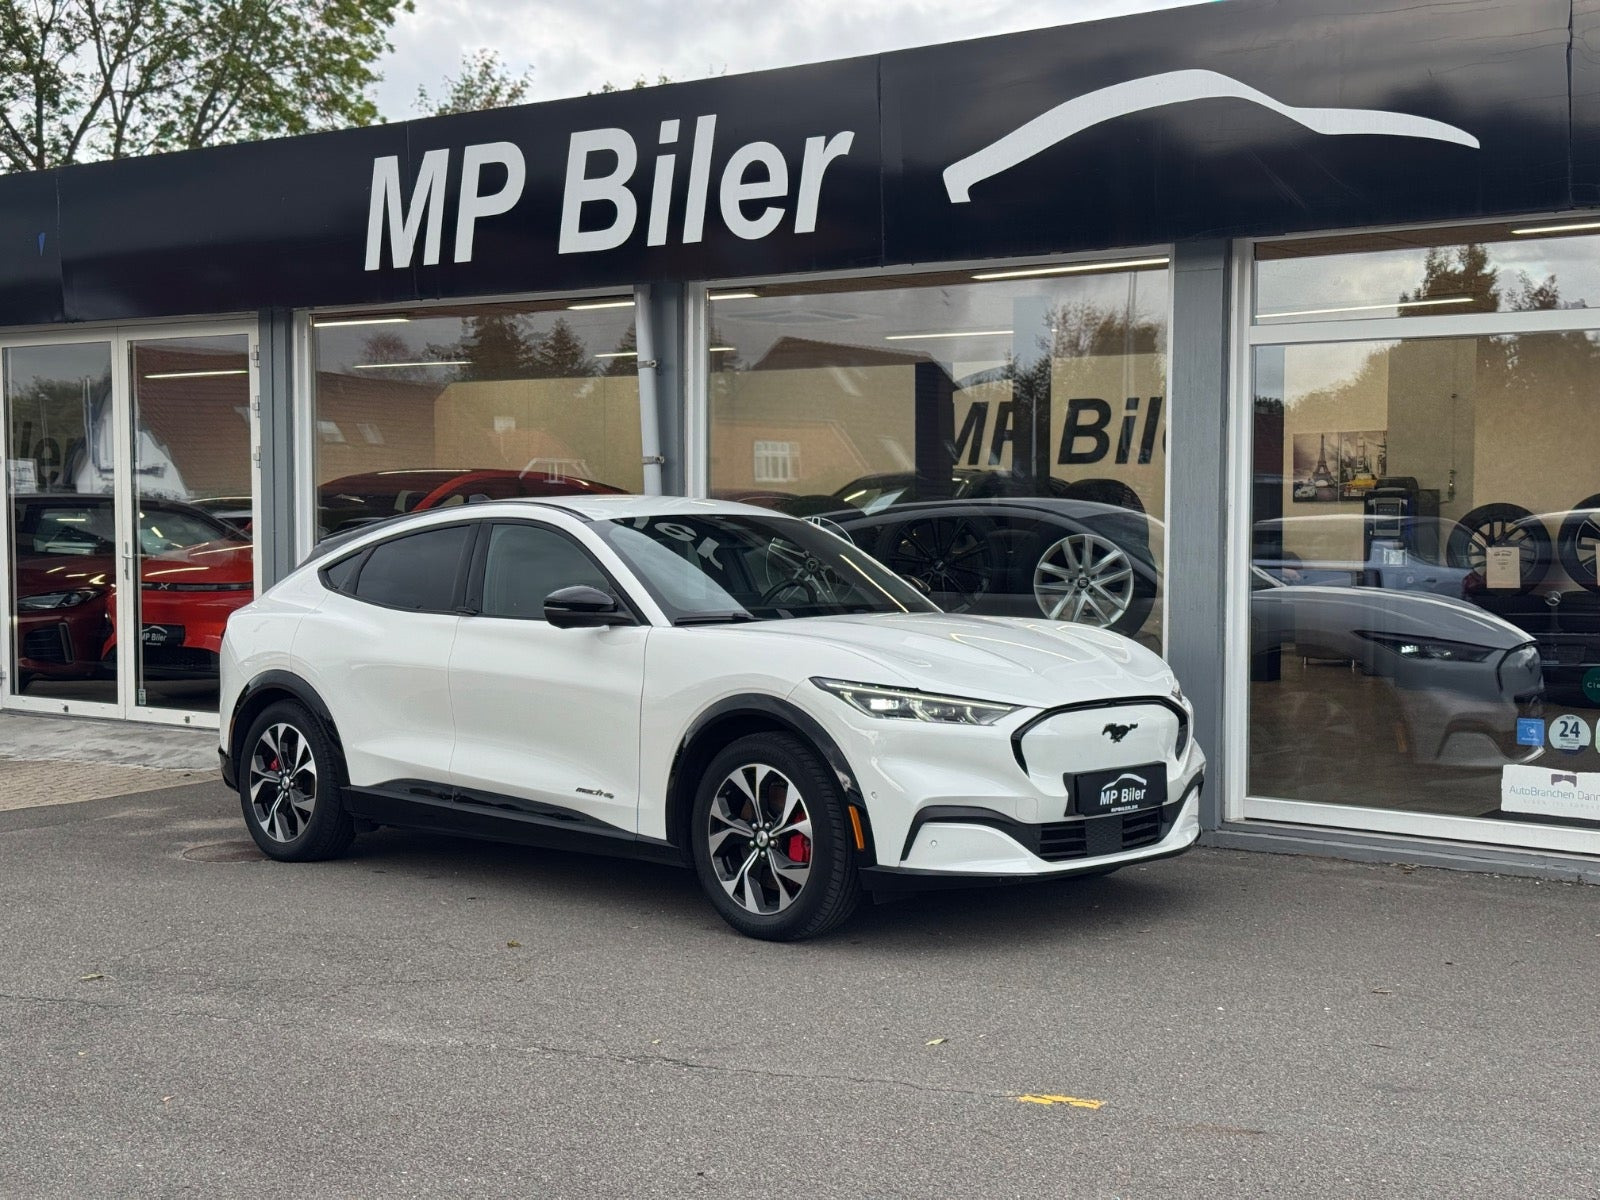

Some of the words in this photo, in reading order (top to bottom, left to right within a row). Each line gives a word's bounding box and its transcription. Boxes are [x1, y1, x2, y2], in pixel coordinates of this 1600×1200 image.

[364, 140, 527, 271] MP
[558, 114, 855, 255] Biler
[1057, 397, 1166, 465] Bil
[1559, 720, 1580, 738] 24
[1100, 790, 1118, 806] MP
[1121, 787, 1146, 803] Biler
[1509, 785, 1575, 800] AutoBranchen
